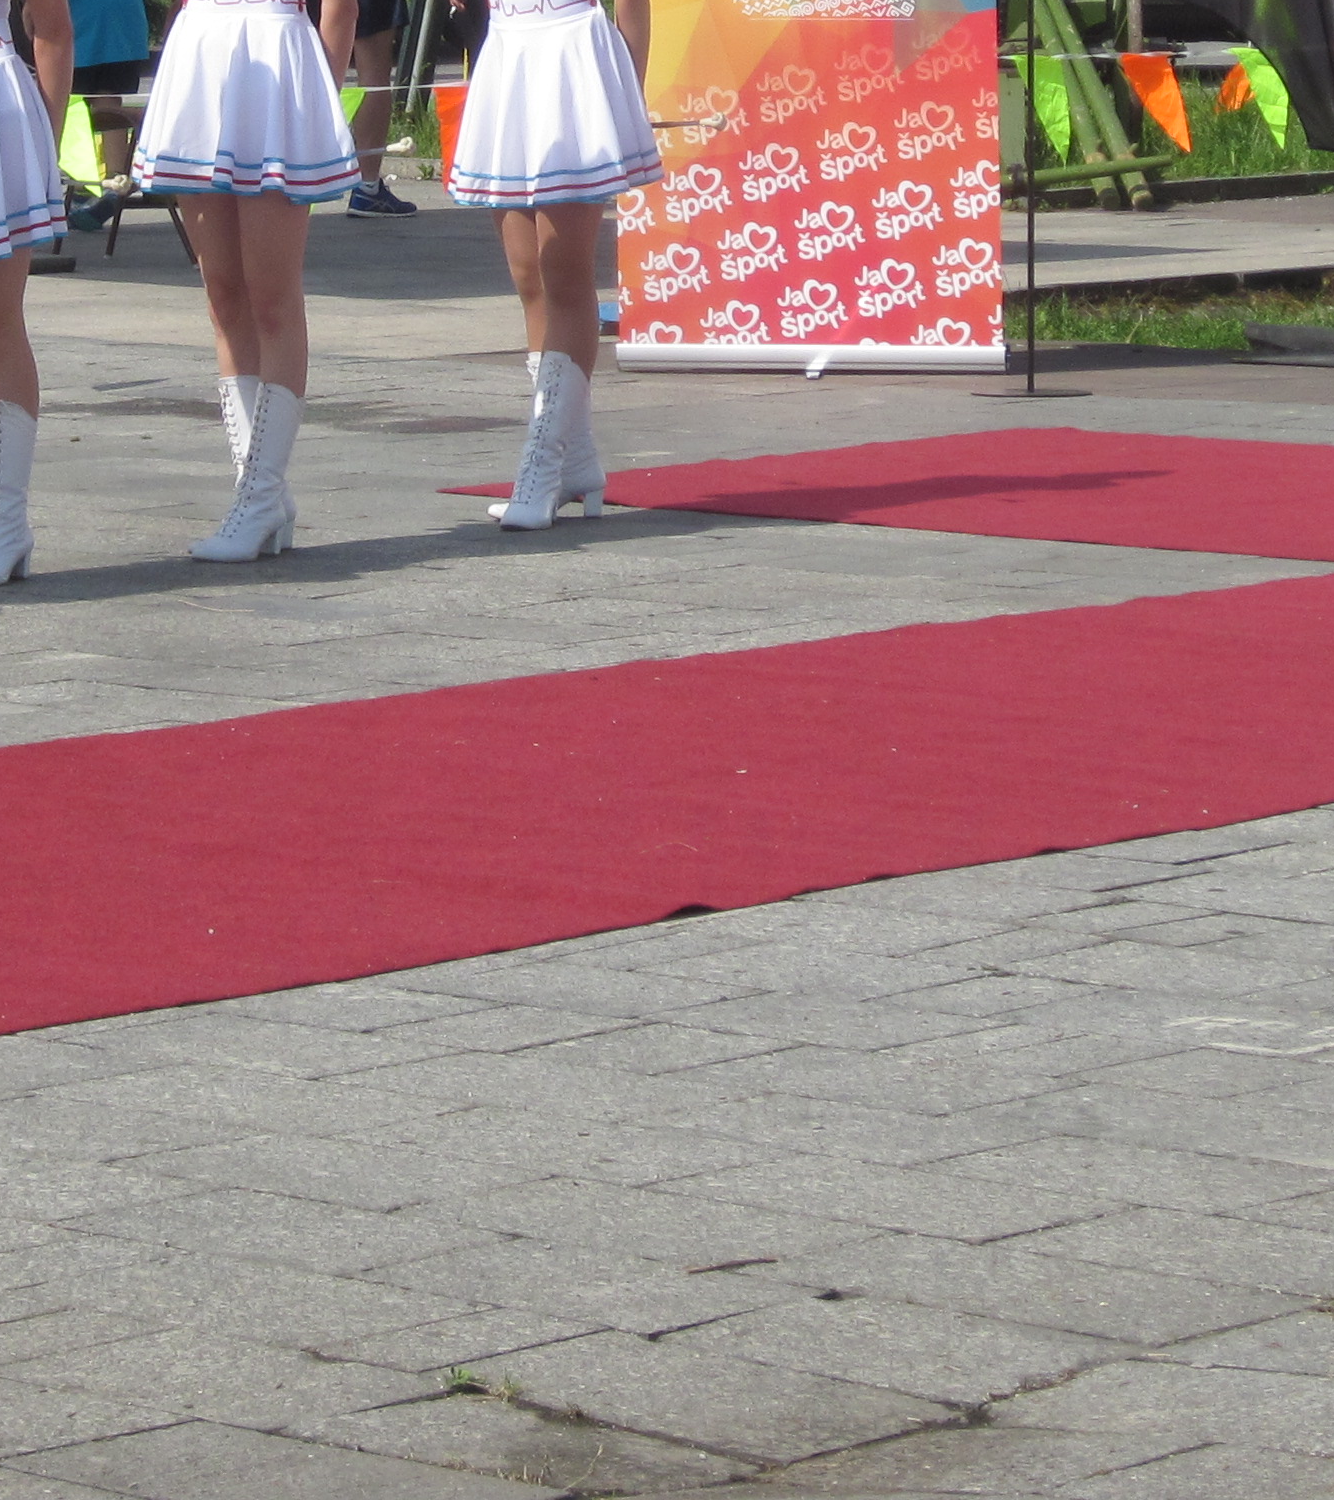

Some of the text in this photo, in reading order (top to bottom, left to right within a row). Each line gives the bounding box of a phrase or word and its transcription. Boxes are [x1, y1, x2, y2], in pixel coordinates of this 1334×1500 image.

[756, 71, 785, 94] Ja
[679, 92, 708, 115] Ja
[760, 88, 827, 124] šport
[972, 88, 998, 110] Ja
[894, 108, 922, 130] Ja
[816, 129, 845, 151] Ja
[897, 124, 966, 161] šport
[739, 150, 767, 173] Ja
[819, 145, 888, 182] šport
[661, 171, 690, 194] Ja
[743, 165, 810, 203] šport
[949, 166, 979, 190] Ja
[665, 186, 732, 224] šport
[871, 187, 901, 210] Ja
[794, 208, 823, 231] Ja
[875, 203, 944, 241] šport
[717, 228, 746, 252] Ja
[797, 224, 865, 261] šport
[640, 250, 669, 273] Ja
[720, 245, 788, 282] šport
[932, 245, 961, 268] Ja
[644, 266, 711, 303] šport
[854, 266, 883, 289] Ja
[936, 260, 1002, 298] šport
[777, 286, 806, 310] Ja
[858, 282, 926, 319] šport
[700, 307, 729, 330] Ja
[780, 302, 849, 339] šport
[910, 324, 939, 346] Ja
